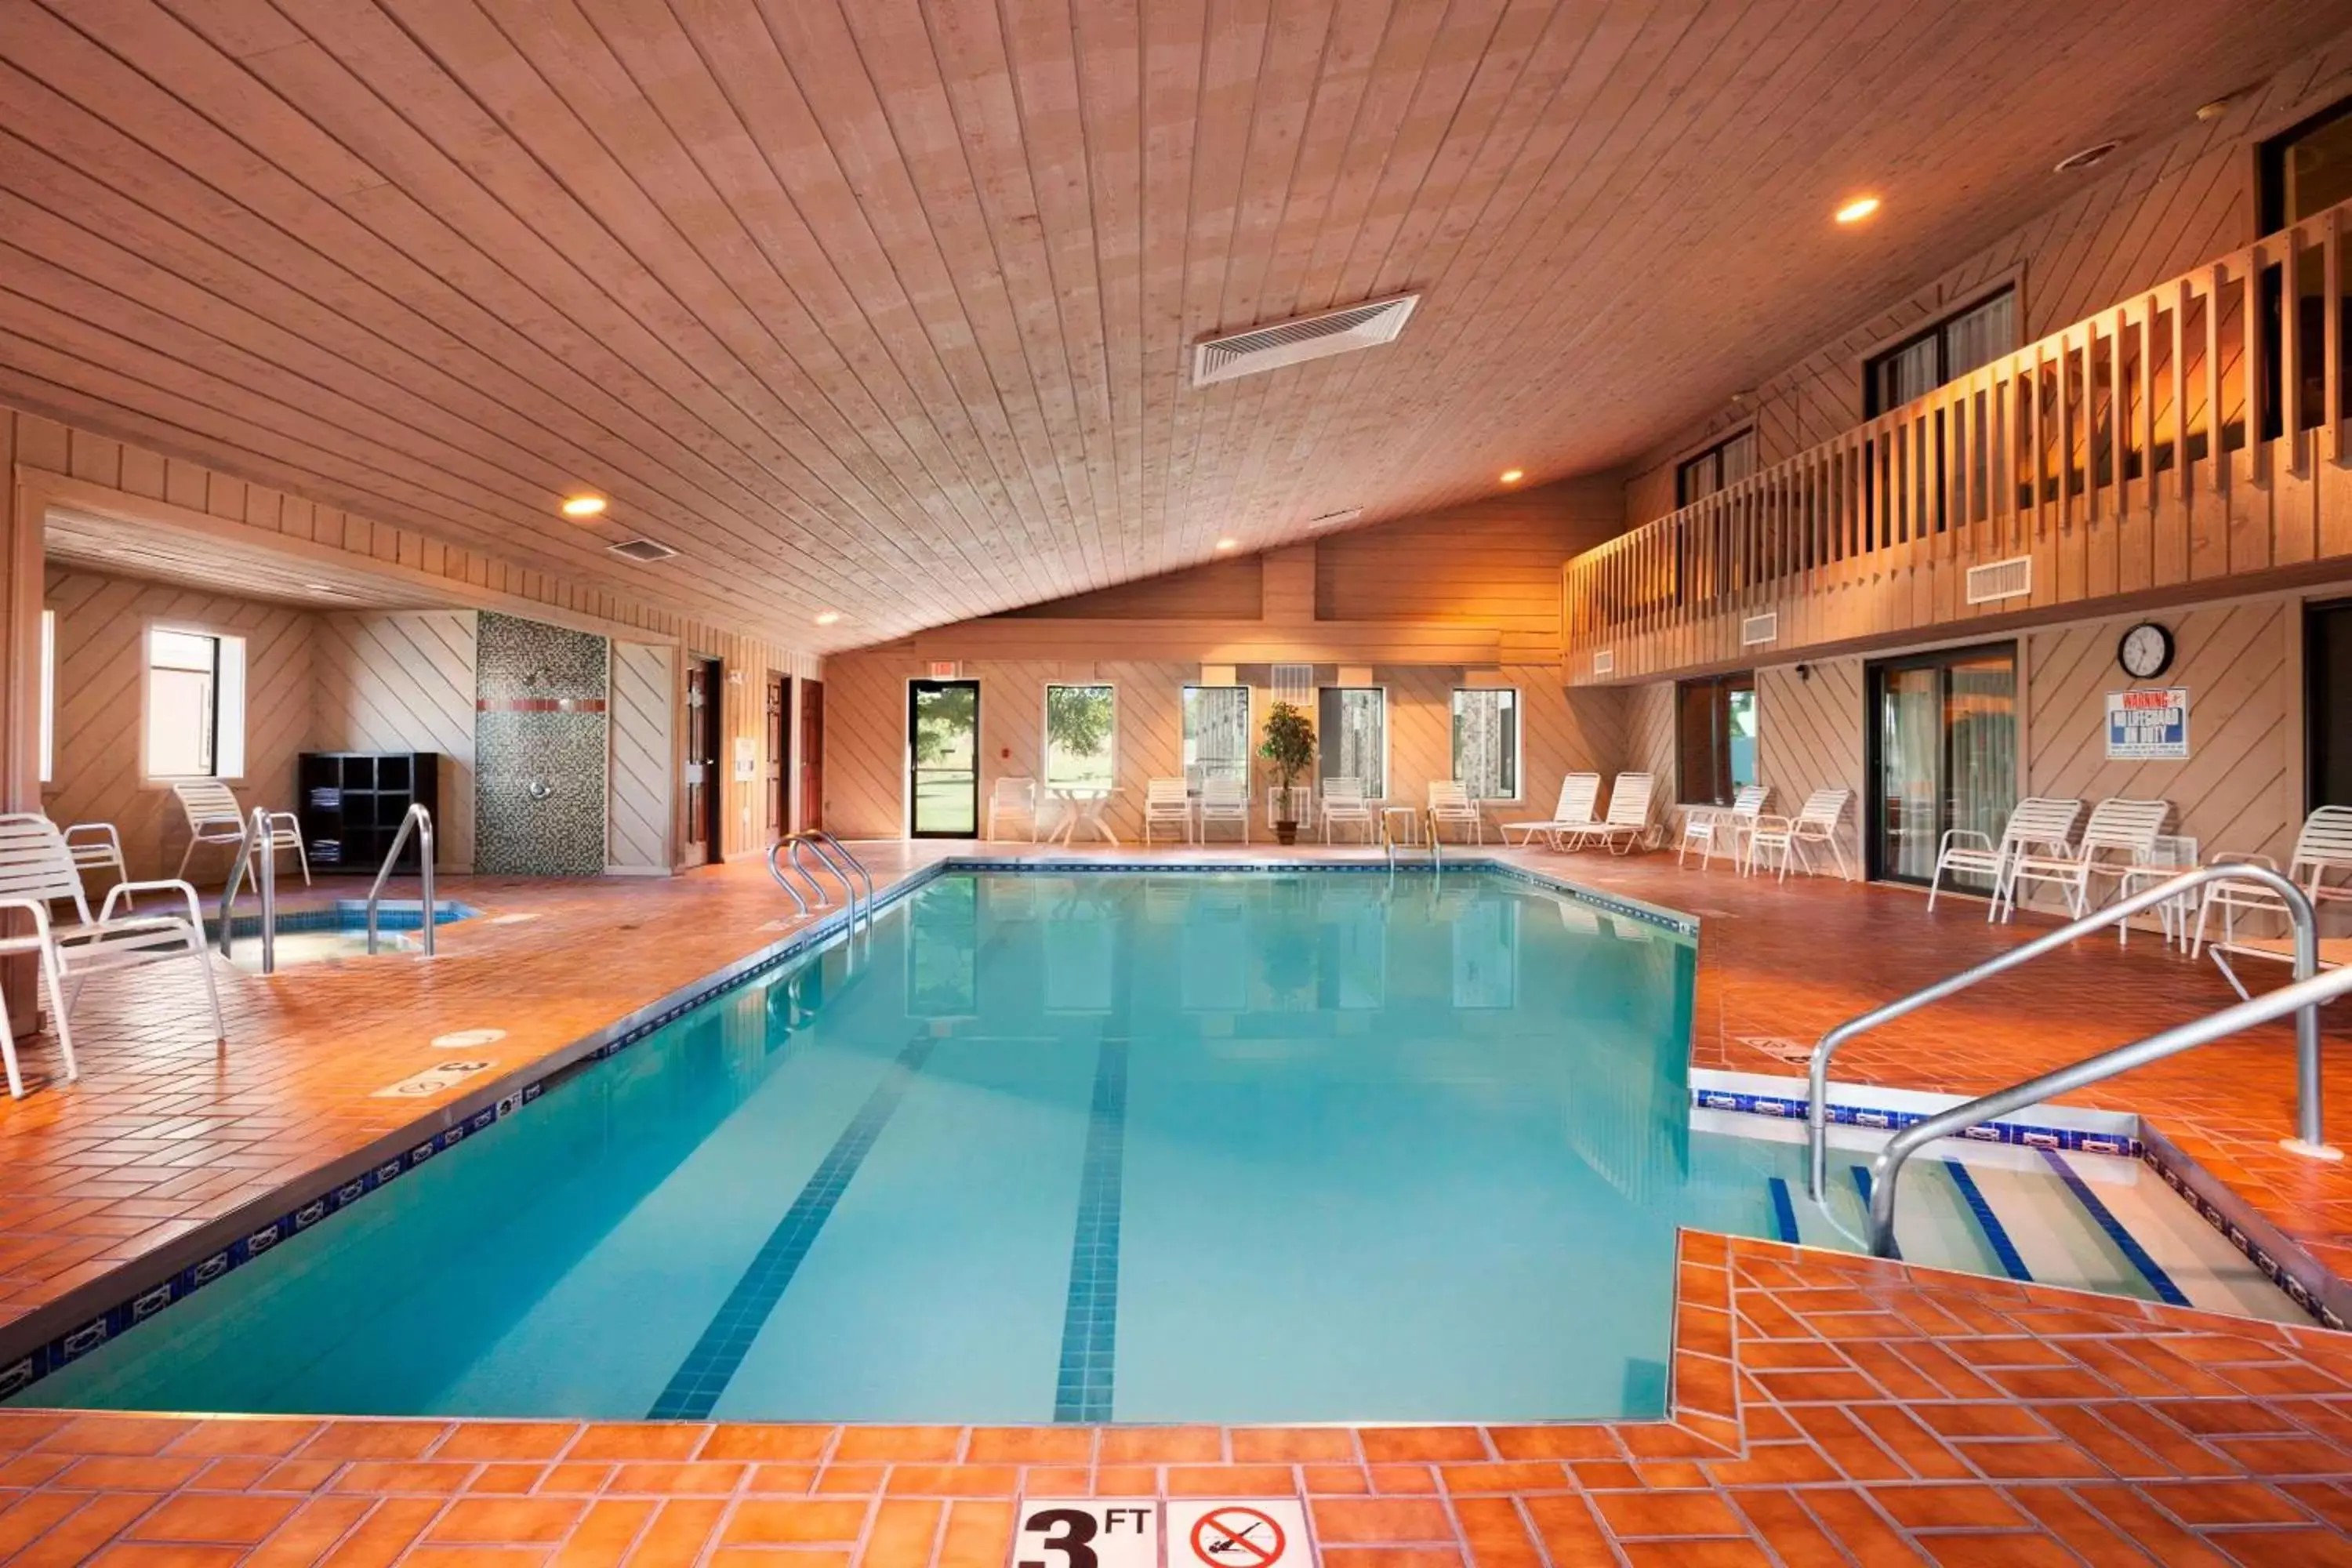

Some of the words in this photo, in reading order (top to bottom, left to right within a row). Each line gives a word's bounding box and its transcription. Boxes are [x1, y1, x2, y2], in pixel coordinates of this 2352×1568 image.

[2123, 691, 2169, 710] WARNING
[1018, 1508, 1098, 1568] 3
[1105, 1509, 1152, 1534] FT
